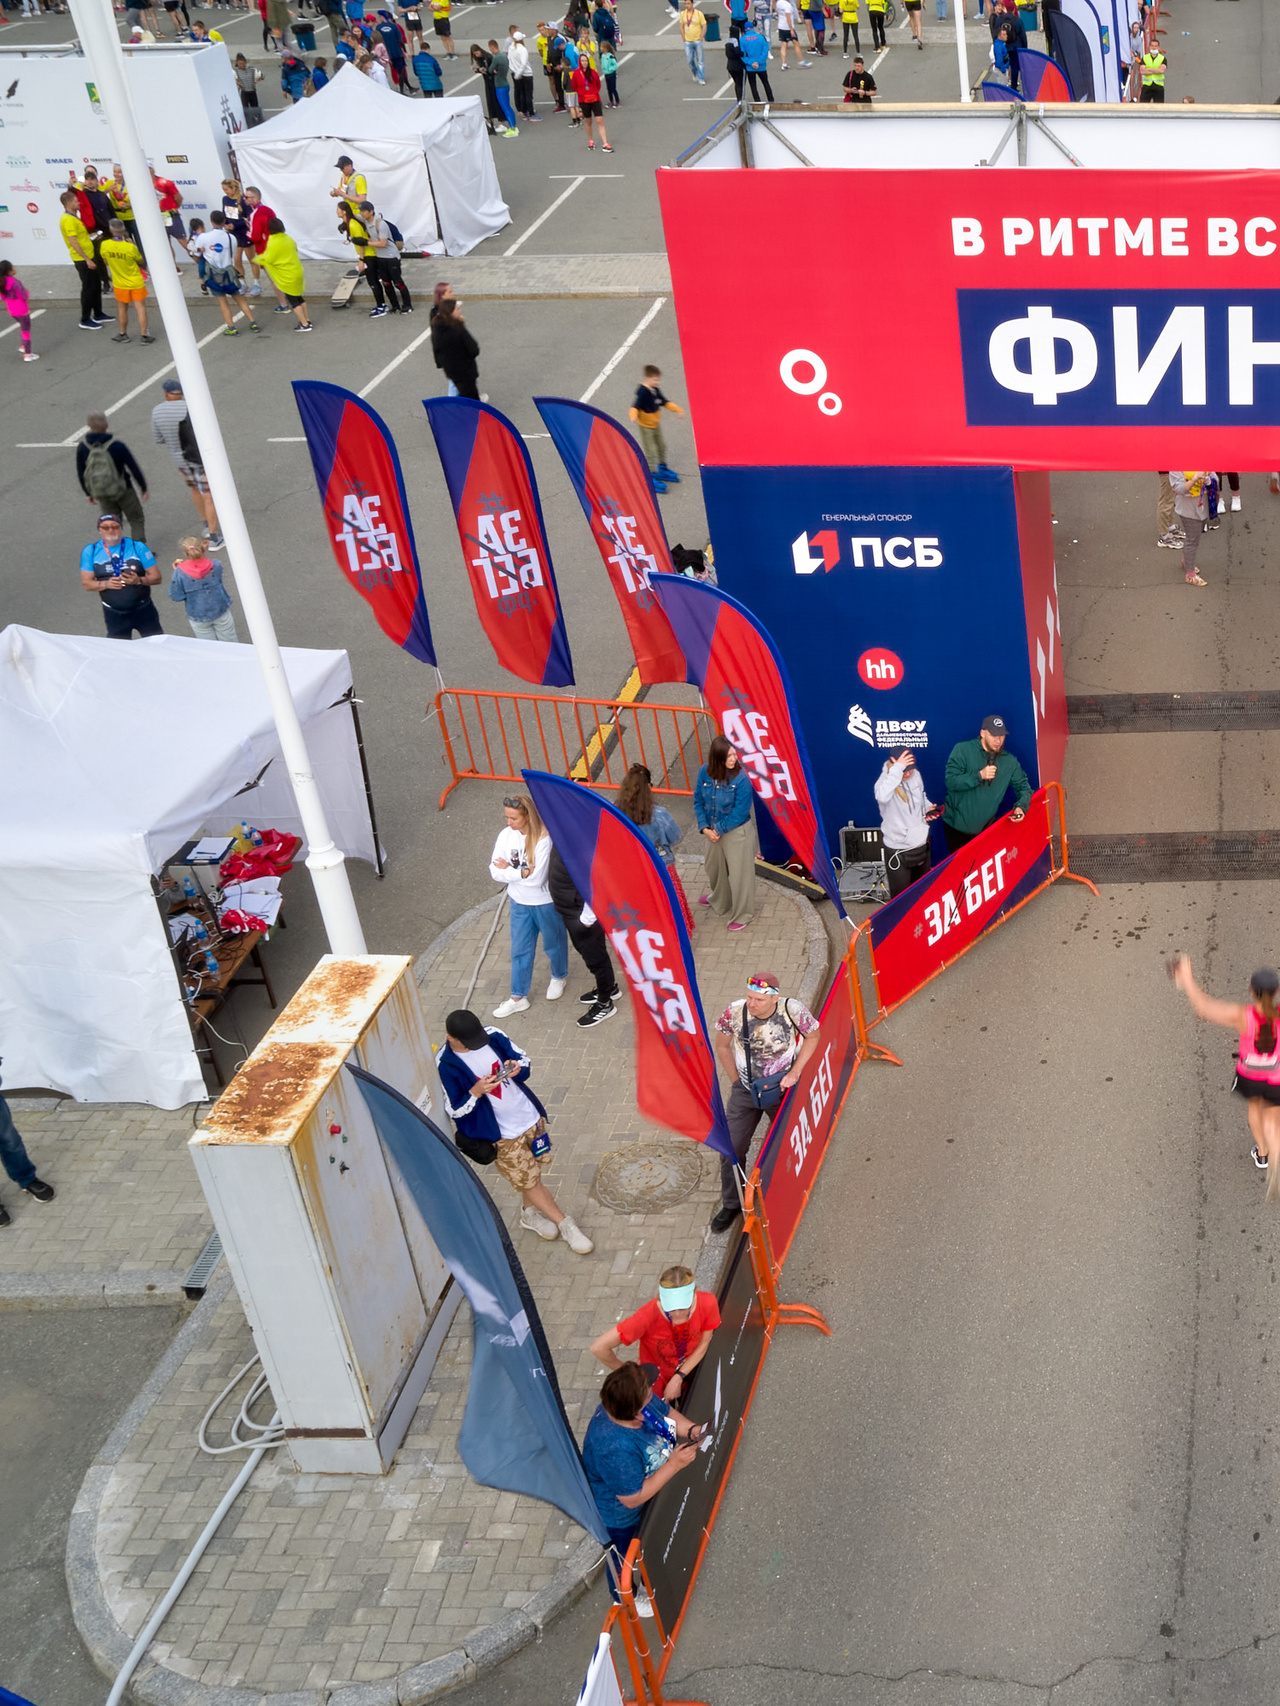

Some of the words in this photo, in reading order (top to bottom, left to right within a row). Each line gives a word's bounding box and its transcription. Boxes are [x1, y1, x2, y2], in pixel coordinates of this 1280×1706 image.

[951, 217, 985, 257] В
[1001, 217, 1189, 257] РИТМЕ
[822, 513, 876, 522] ГЕНЕРАЛЬНЫЙ
[876, 514, 913, 522] СПОНСОР
[851, 536, 943, 568] ПСБ
[866, 658, 896, 679] hh
[875, 720, 927, 733] ДВФУ
